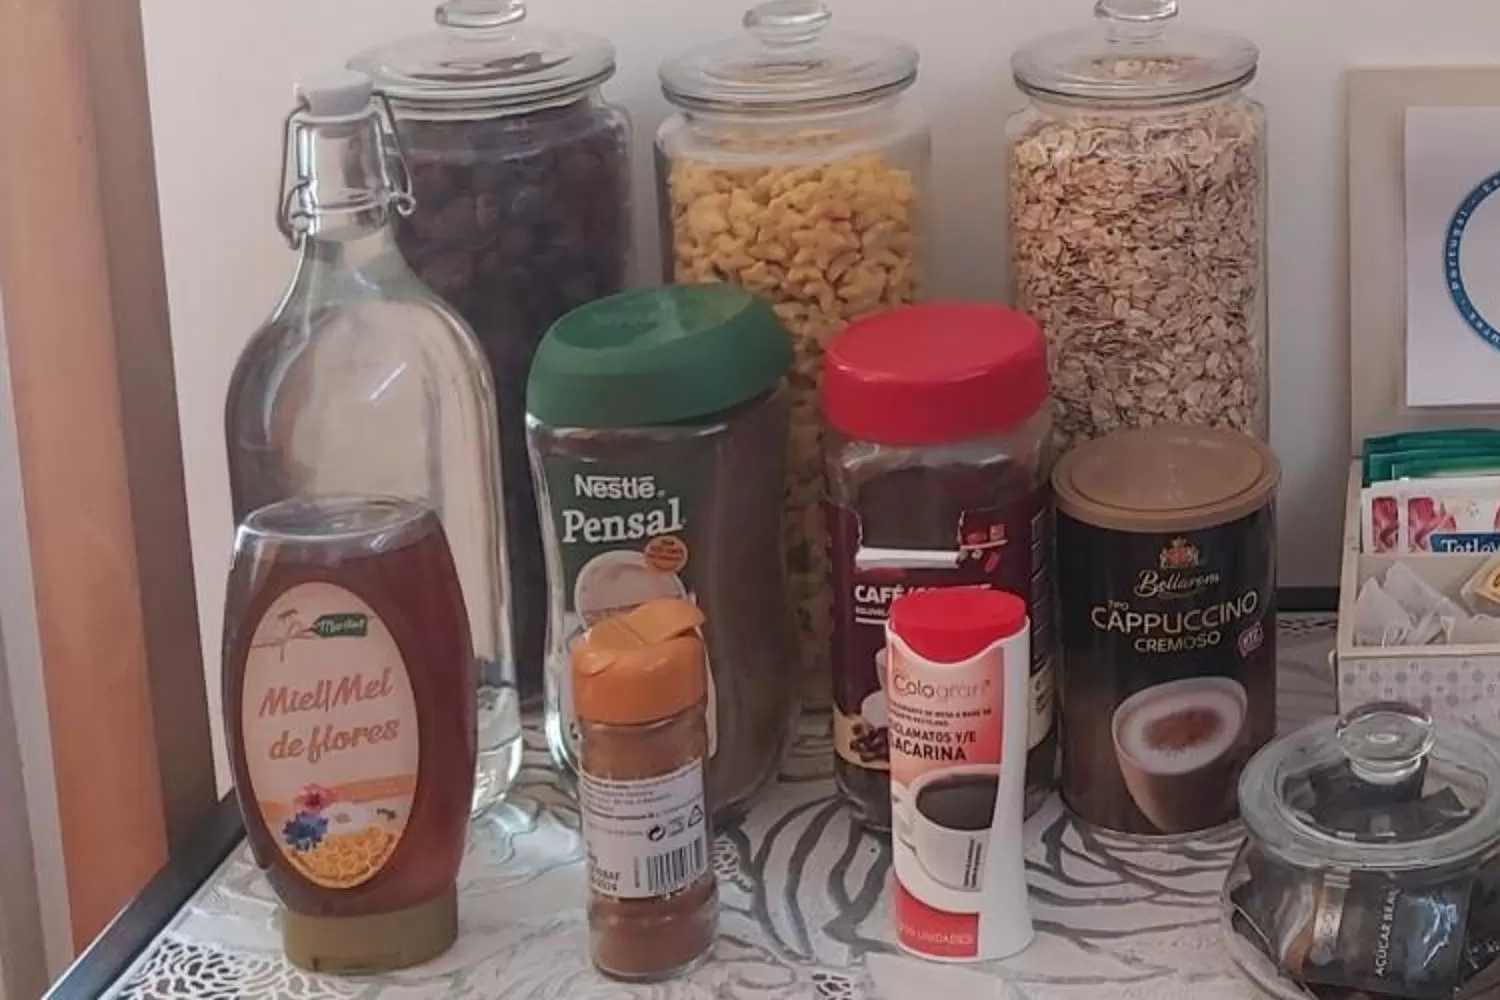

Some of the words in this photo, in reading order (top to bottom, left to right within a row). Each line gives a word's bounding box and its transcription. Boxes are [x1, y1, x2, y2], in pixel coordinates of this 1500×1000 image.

[573, 473, 656, 499] Nestlé
[561, 497, 684, 544] Pensal
[854, 583, 905, 604] CAFÉ
[1091, 590, 1258, 635] CAPPUCCINO
[1133, 631, 1221, 654] CREMOSO
[894, 672, 984, 703] Cologran
[268, 730, 303, 762] de
[307, 718, 400, 765] flores
